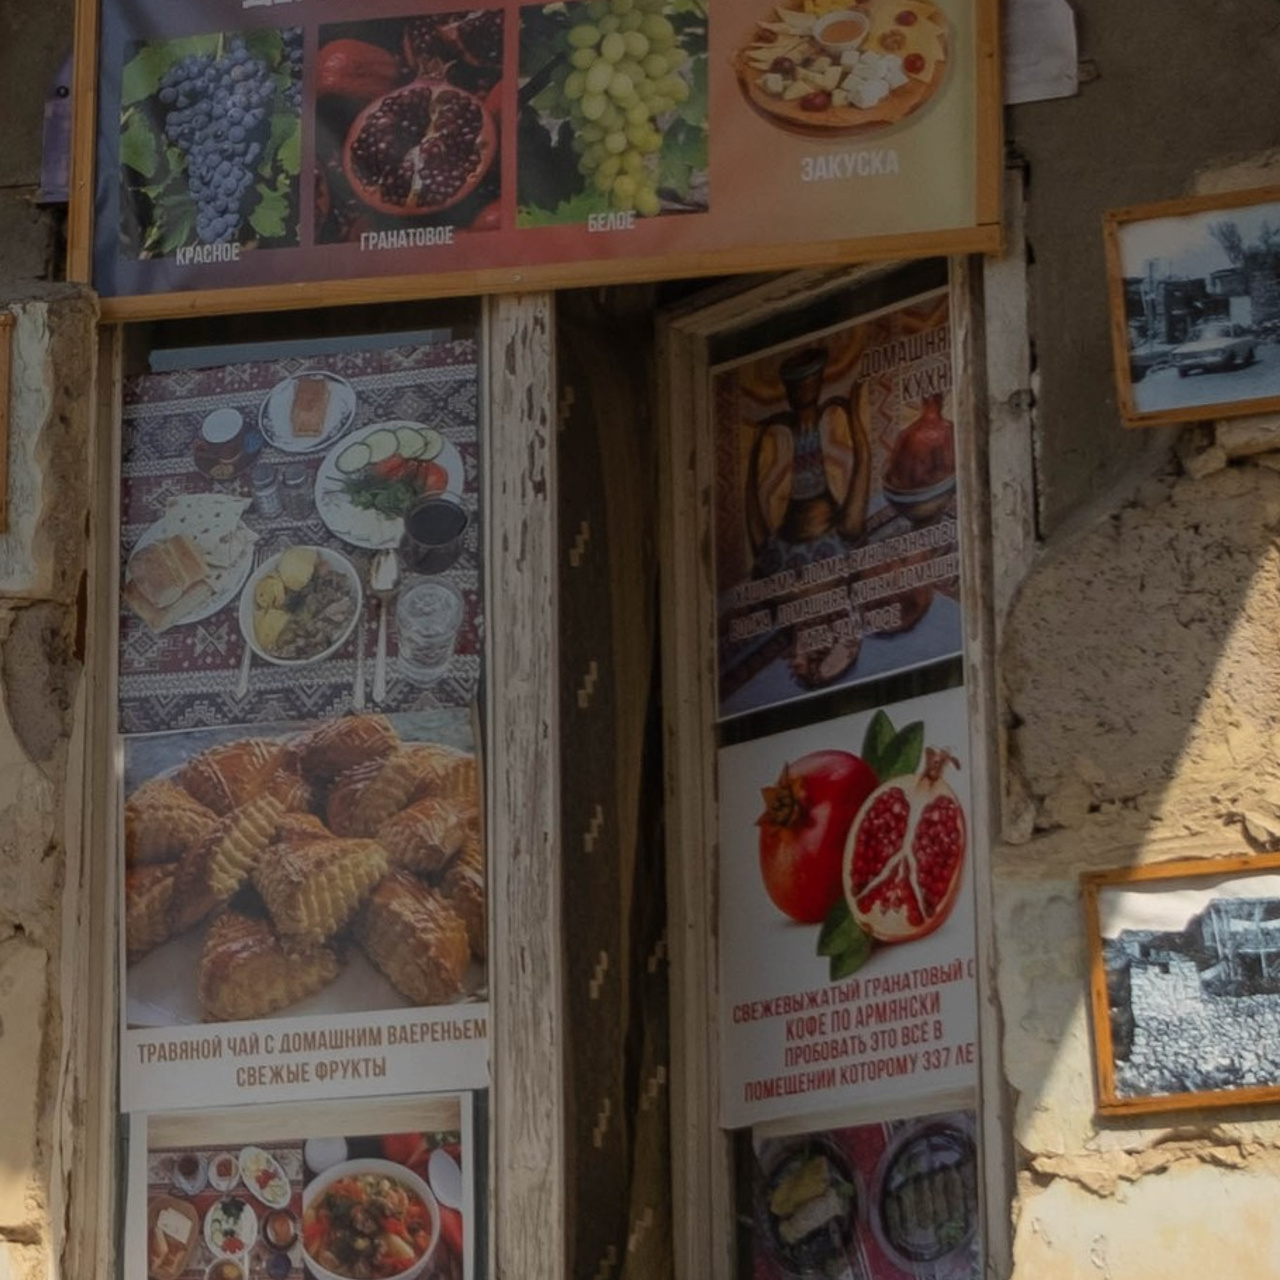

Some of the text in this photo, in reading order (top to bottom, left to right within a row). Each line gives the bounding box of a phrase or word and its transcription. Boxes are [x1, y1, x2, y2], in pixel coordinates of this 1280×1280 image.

[800, 149, 900, 182] ЗАКУСКА
[360, 227, 454, 251] ГРАНАТОВОЕ
[587, 211, 635, 234] БЕЛОЕ
[176, 243, 240, 266] КРАСНОЕ
[733, 979, 860, 1024] СВЕЖЕВЫЖАТЫЙ
[864, 958, 963, 999] ГРАНАТОВЫЙ
[786, 991, 941, 1041] КОФЕ ПО АРМЯНСКИ
[138, 1018, 487, 1064] ТРАВЯНОЙ ЧАЙ С ДОМАШНИМ ВАЕРЕНЬЕМ
[785, 1036, 866, 1067] ПРОБОВАТЬ
[871, 1029, 897, 1052] ЭТО
[933, 1020, 943, 1040] В
[237, 1057, 386, 1087] СВЕЖЫЕ ФРУКТЫ
[744, 1069, 836, 1102] ПОМЕЩЕНИИ
[840, 1052, 918, 1086] КОТОРОМУ
[922, 1047, 951, 1071] 337
